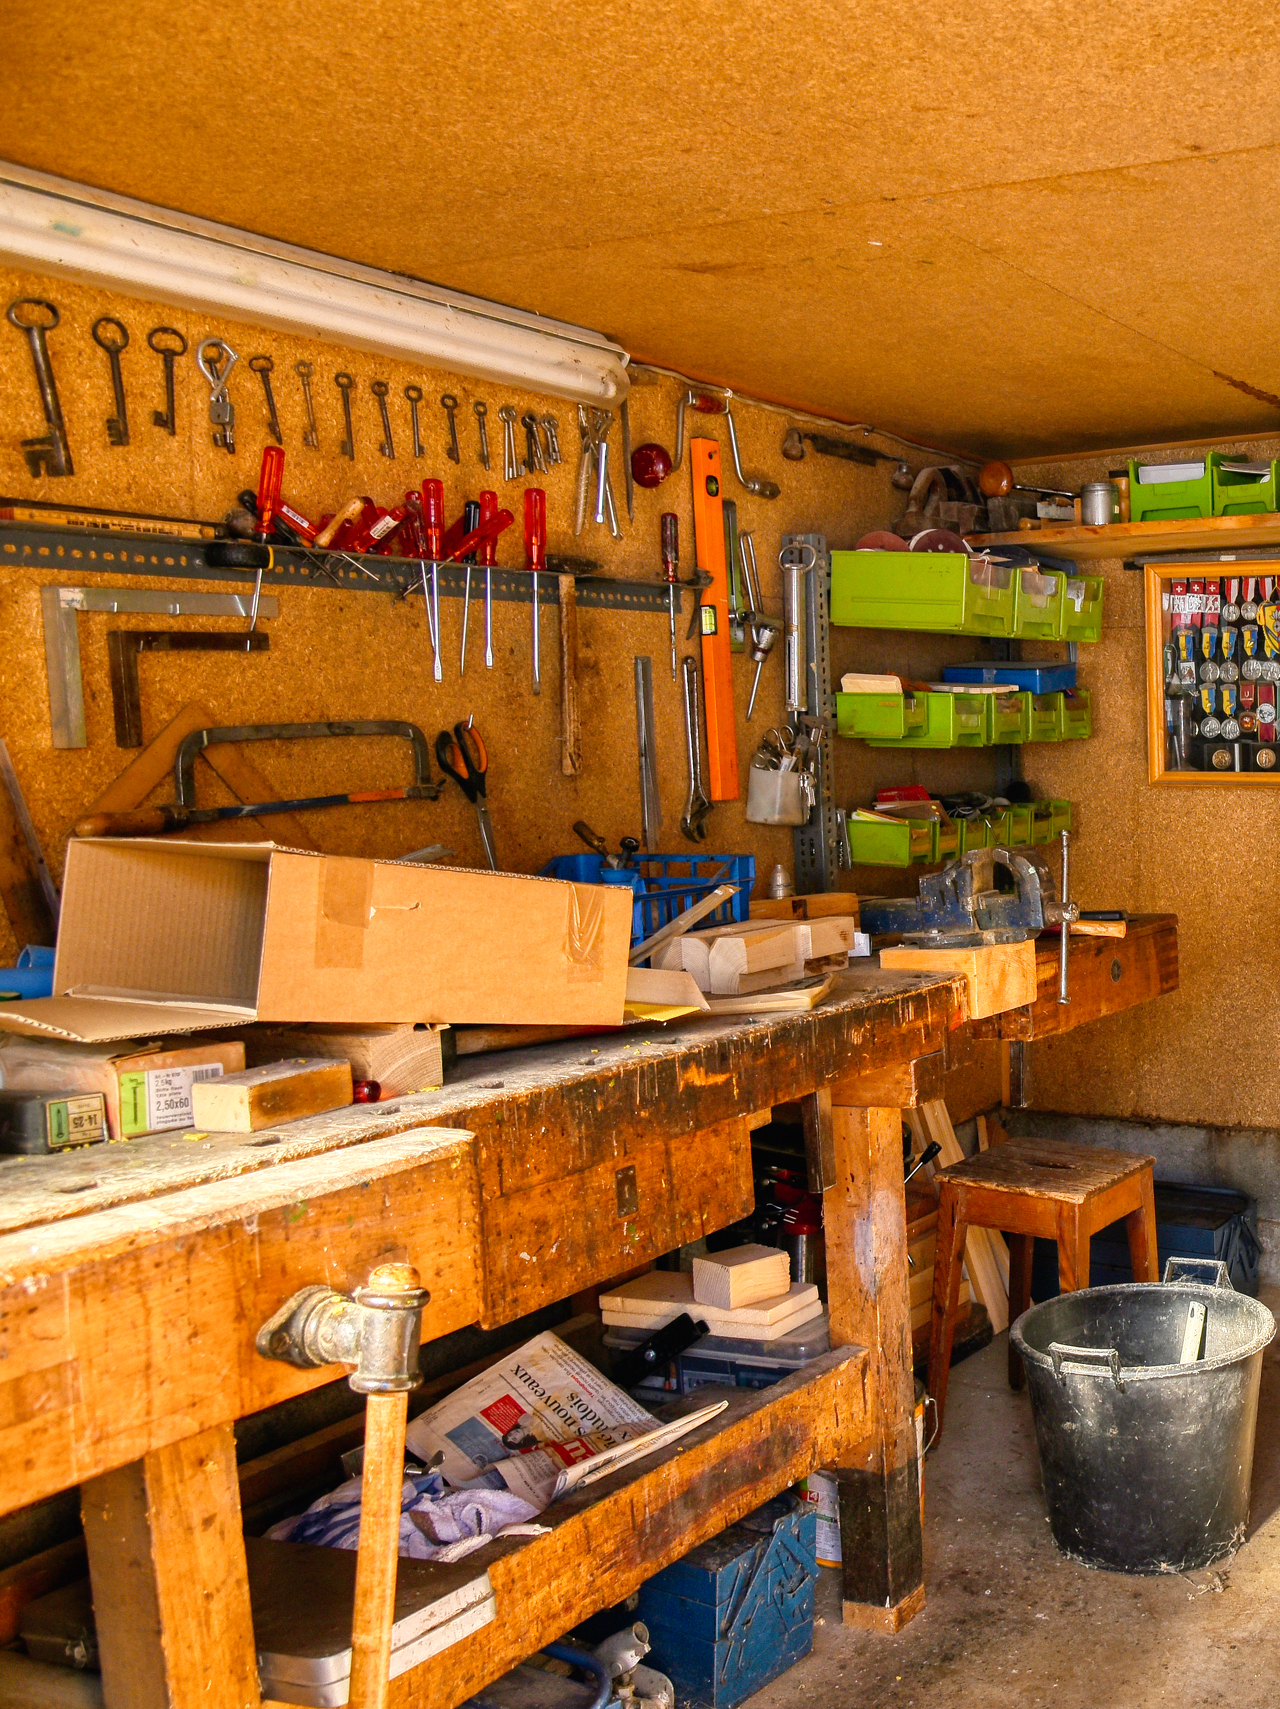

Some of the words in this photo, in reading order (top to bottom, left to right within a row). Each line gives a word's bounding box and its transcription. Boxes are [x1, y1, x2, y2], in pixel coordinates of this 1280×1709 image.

[156, 1097, 190, 1112] 2,50x60
[72, 1113, 98, 1130] 14-25
[509, 1363, 578, 1429] nouveaux
